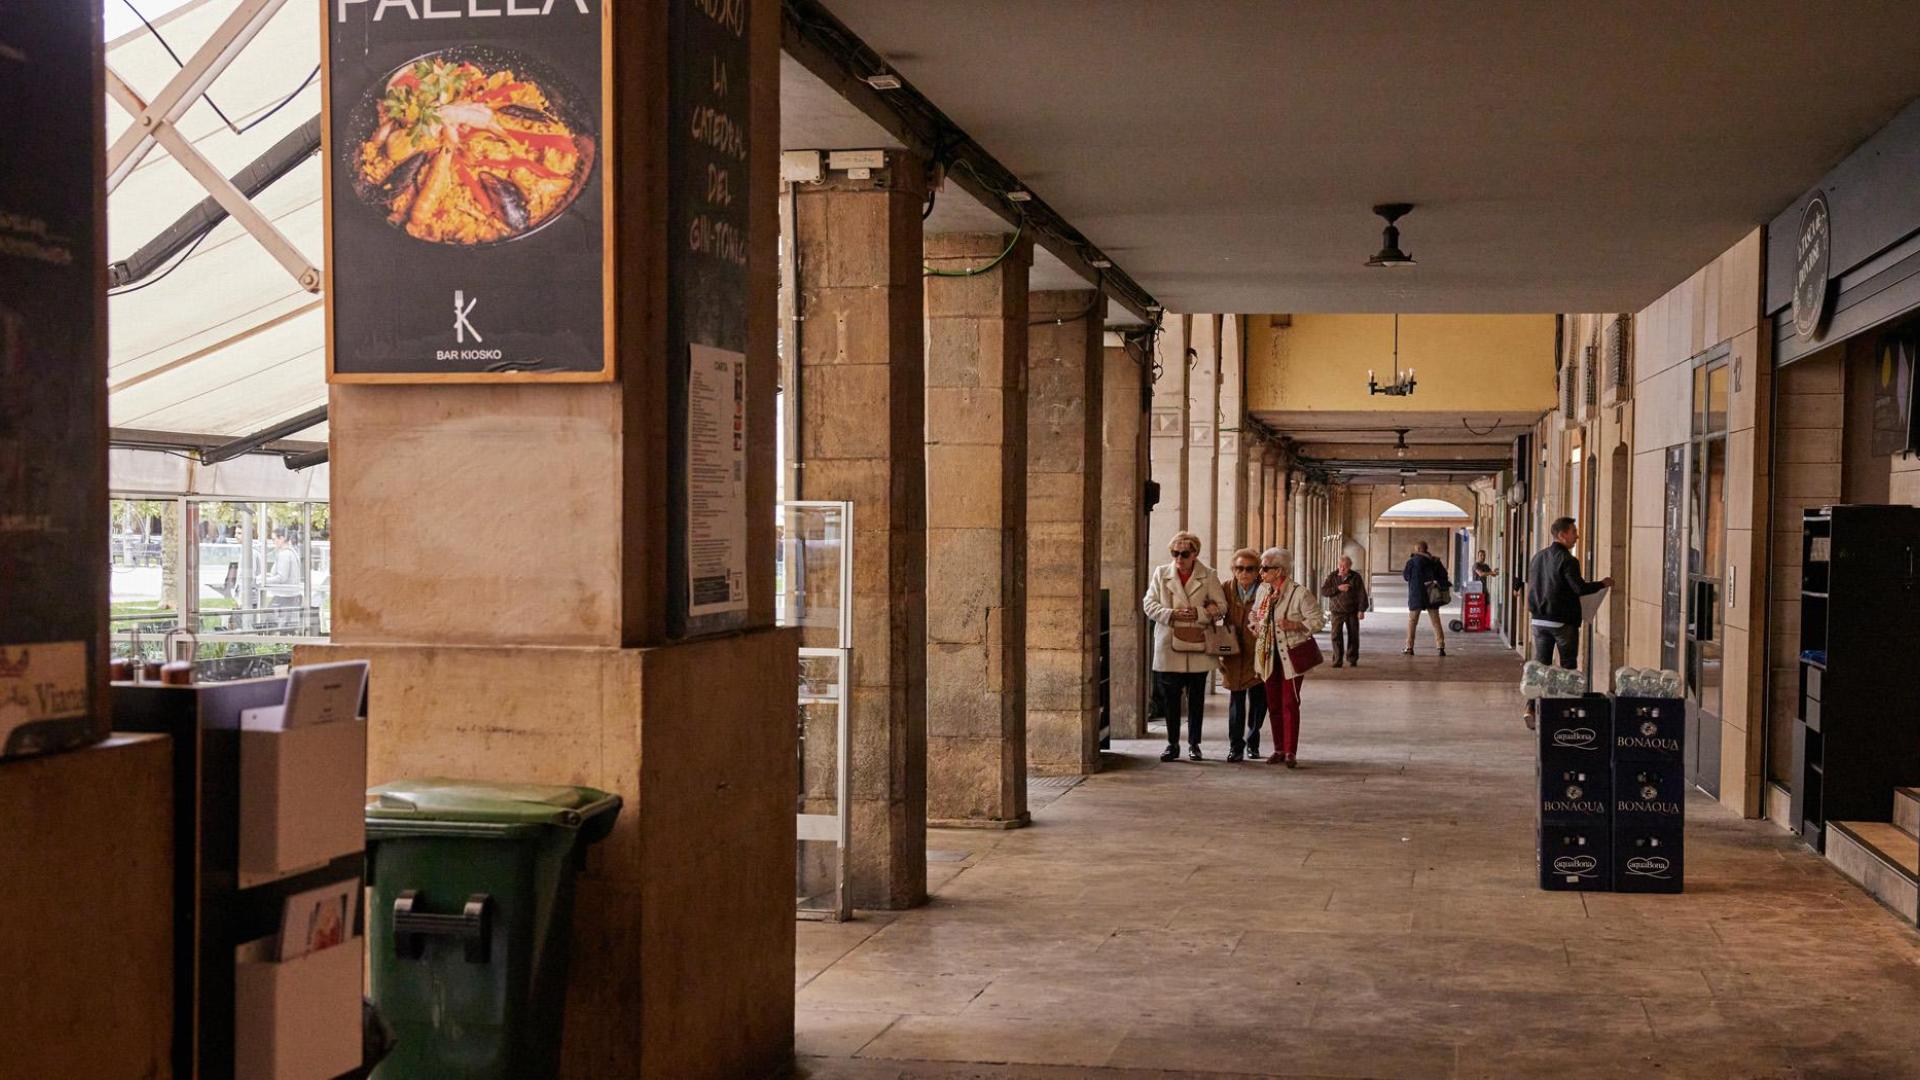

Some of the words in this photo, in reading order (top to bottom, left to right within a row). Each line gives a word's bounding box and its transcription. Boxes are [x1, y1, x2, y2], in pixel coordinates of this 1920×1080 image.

[694, 0, 745, 37] OSKO
[713, 55, 729, 97] LA
[691, 104, 747, 162] CATEDRAL
[707, 162, 732, 208] DEL
[436, 350, 459, 360] BAR
[461, 349, 502, 360] KIOSKO
[1617, 736, 1680, 751] BONAQUA
[1544, 801, 1605, 814] BONAQUA
[1618, 801, 1680, 814] BONAQUA
